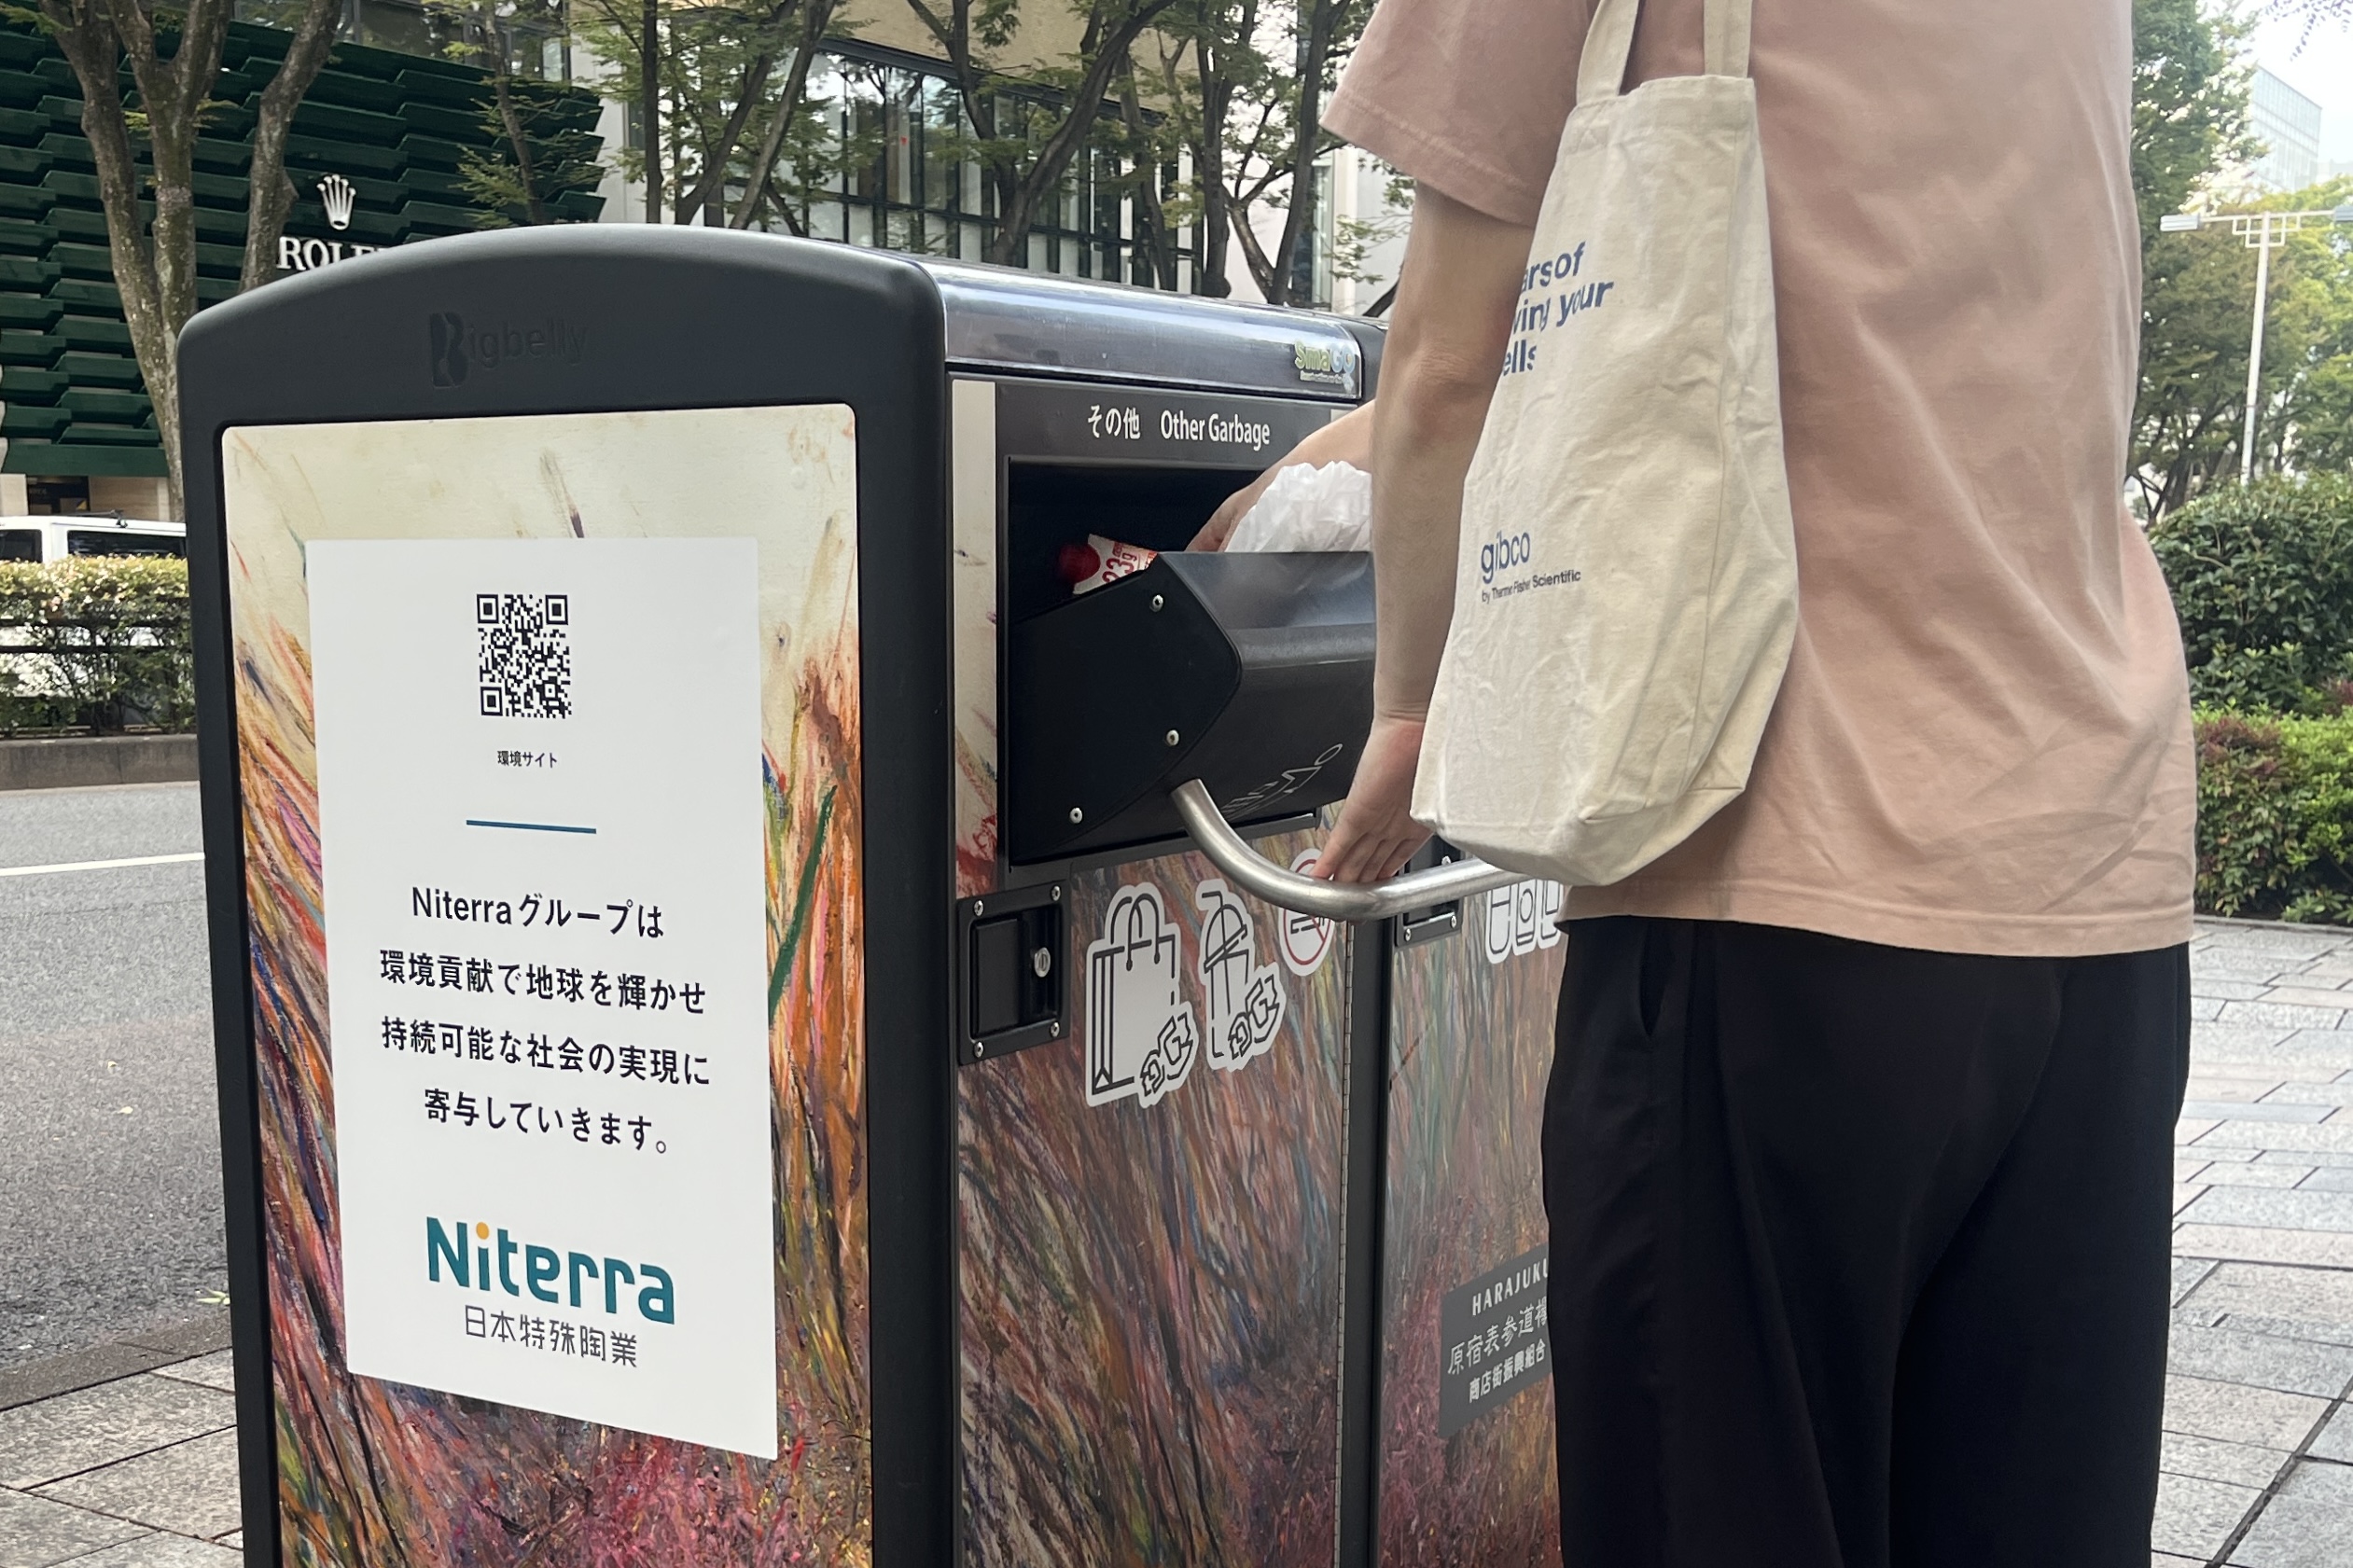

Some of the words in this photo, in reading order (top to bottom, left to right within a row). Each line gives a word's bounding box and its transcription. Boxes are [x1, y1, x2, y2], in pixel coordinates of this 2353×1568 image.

[1556, 282, 1614, 326] your
[429, 312, 589, 388] Bigbelly
[1088, 405, 1140, 439] その他
[1161, 409, 1205, 441] Other
[1208, 413, 1270, 451] Garbage
[1481, 530, 1530, 584] gibco
[1532, 570, 1581, 589] Scientific
[497, 751, 557, 768] 環境サイト
[412, 887, 664, 938] Niterraグループは
[380, 949, 705, 1014] 環境貢献で地球を輝かせ
[382, 1016, 710, 1085] 持続可能な社会の実現に
[425, 1088, 666, 1154] 寄与していきます。
[426, 1216, 675, 1325] Niterra
[465, 1304, 637, 1367] 日本特殊陶業
